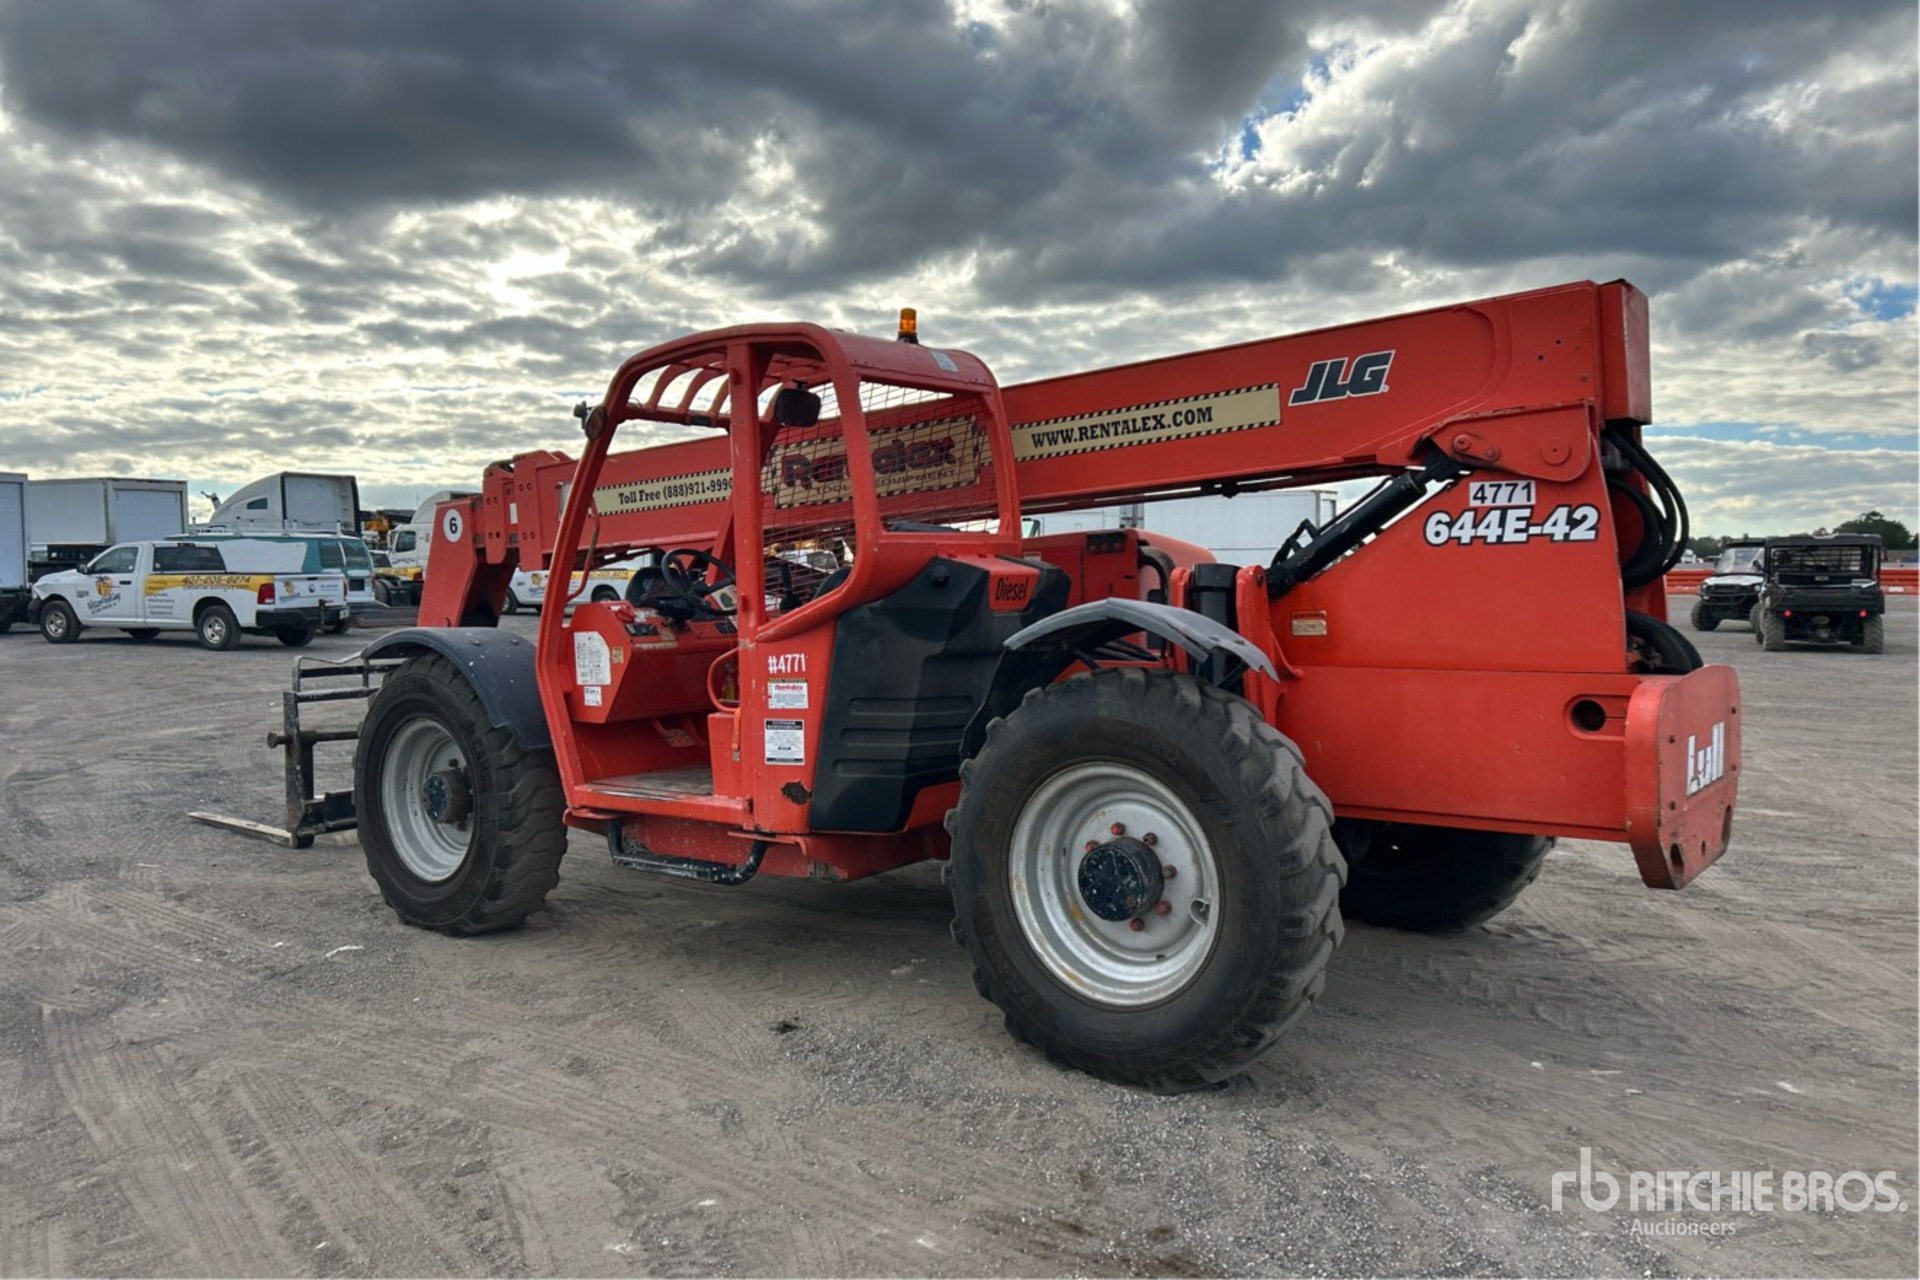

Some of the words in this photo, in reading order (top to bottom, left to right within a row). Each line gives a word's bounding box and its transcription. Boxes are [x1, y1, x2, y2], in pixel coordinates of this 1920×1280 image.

[1288, 350, 1396, 406] JLG
[1031, 406, 1213, 449] WWW.RENTALEX.COM
[618, 491, 637, 505] Toll
[638, 490, 661, 502] Free
[1472, 483, 1533, 503] 4771
[449, 517, 458, 534] 6
[1424, 505, 1600, 546] 644E-42
[995, 577, 1030, 602] Diesel
[767, 653, 806, 674] #4771
